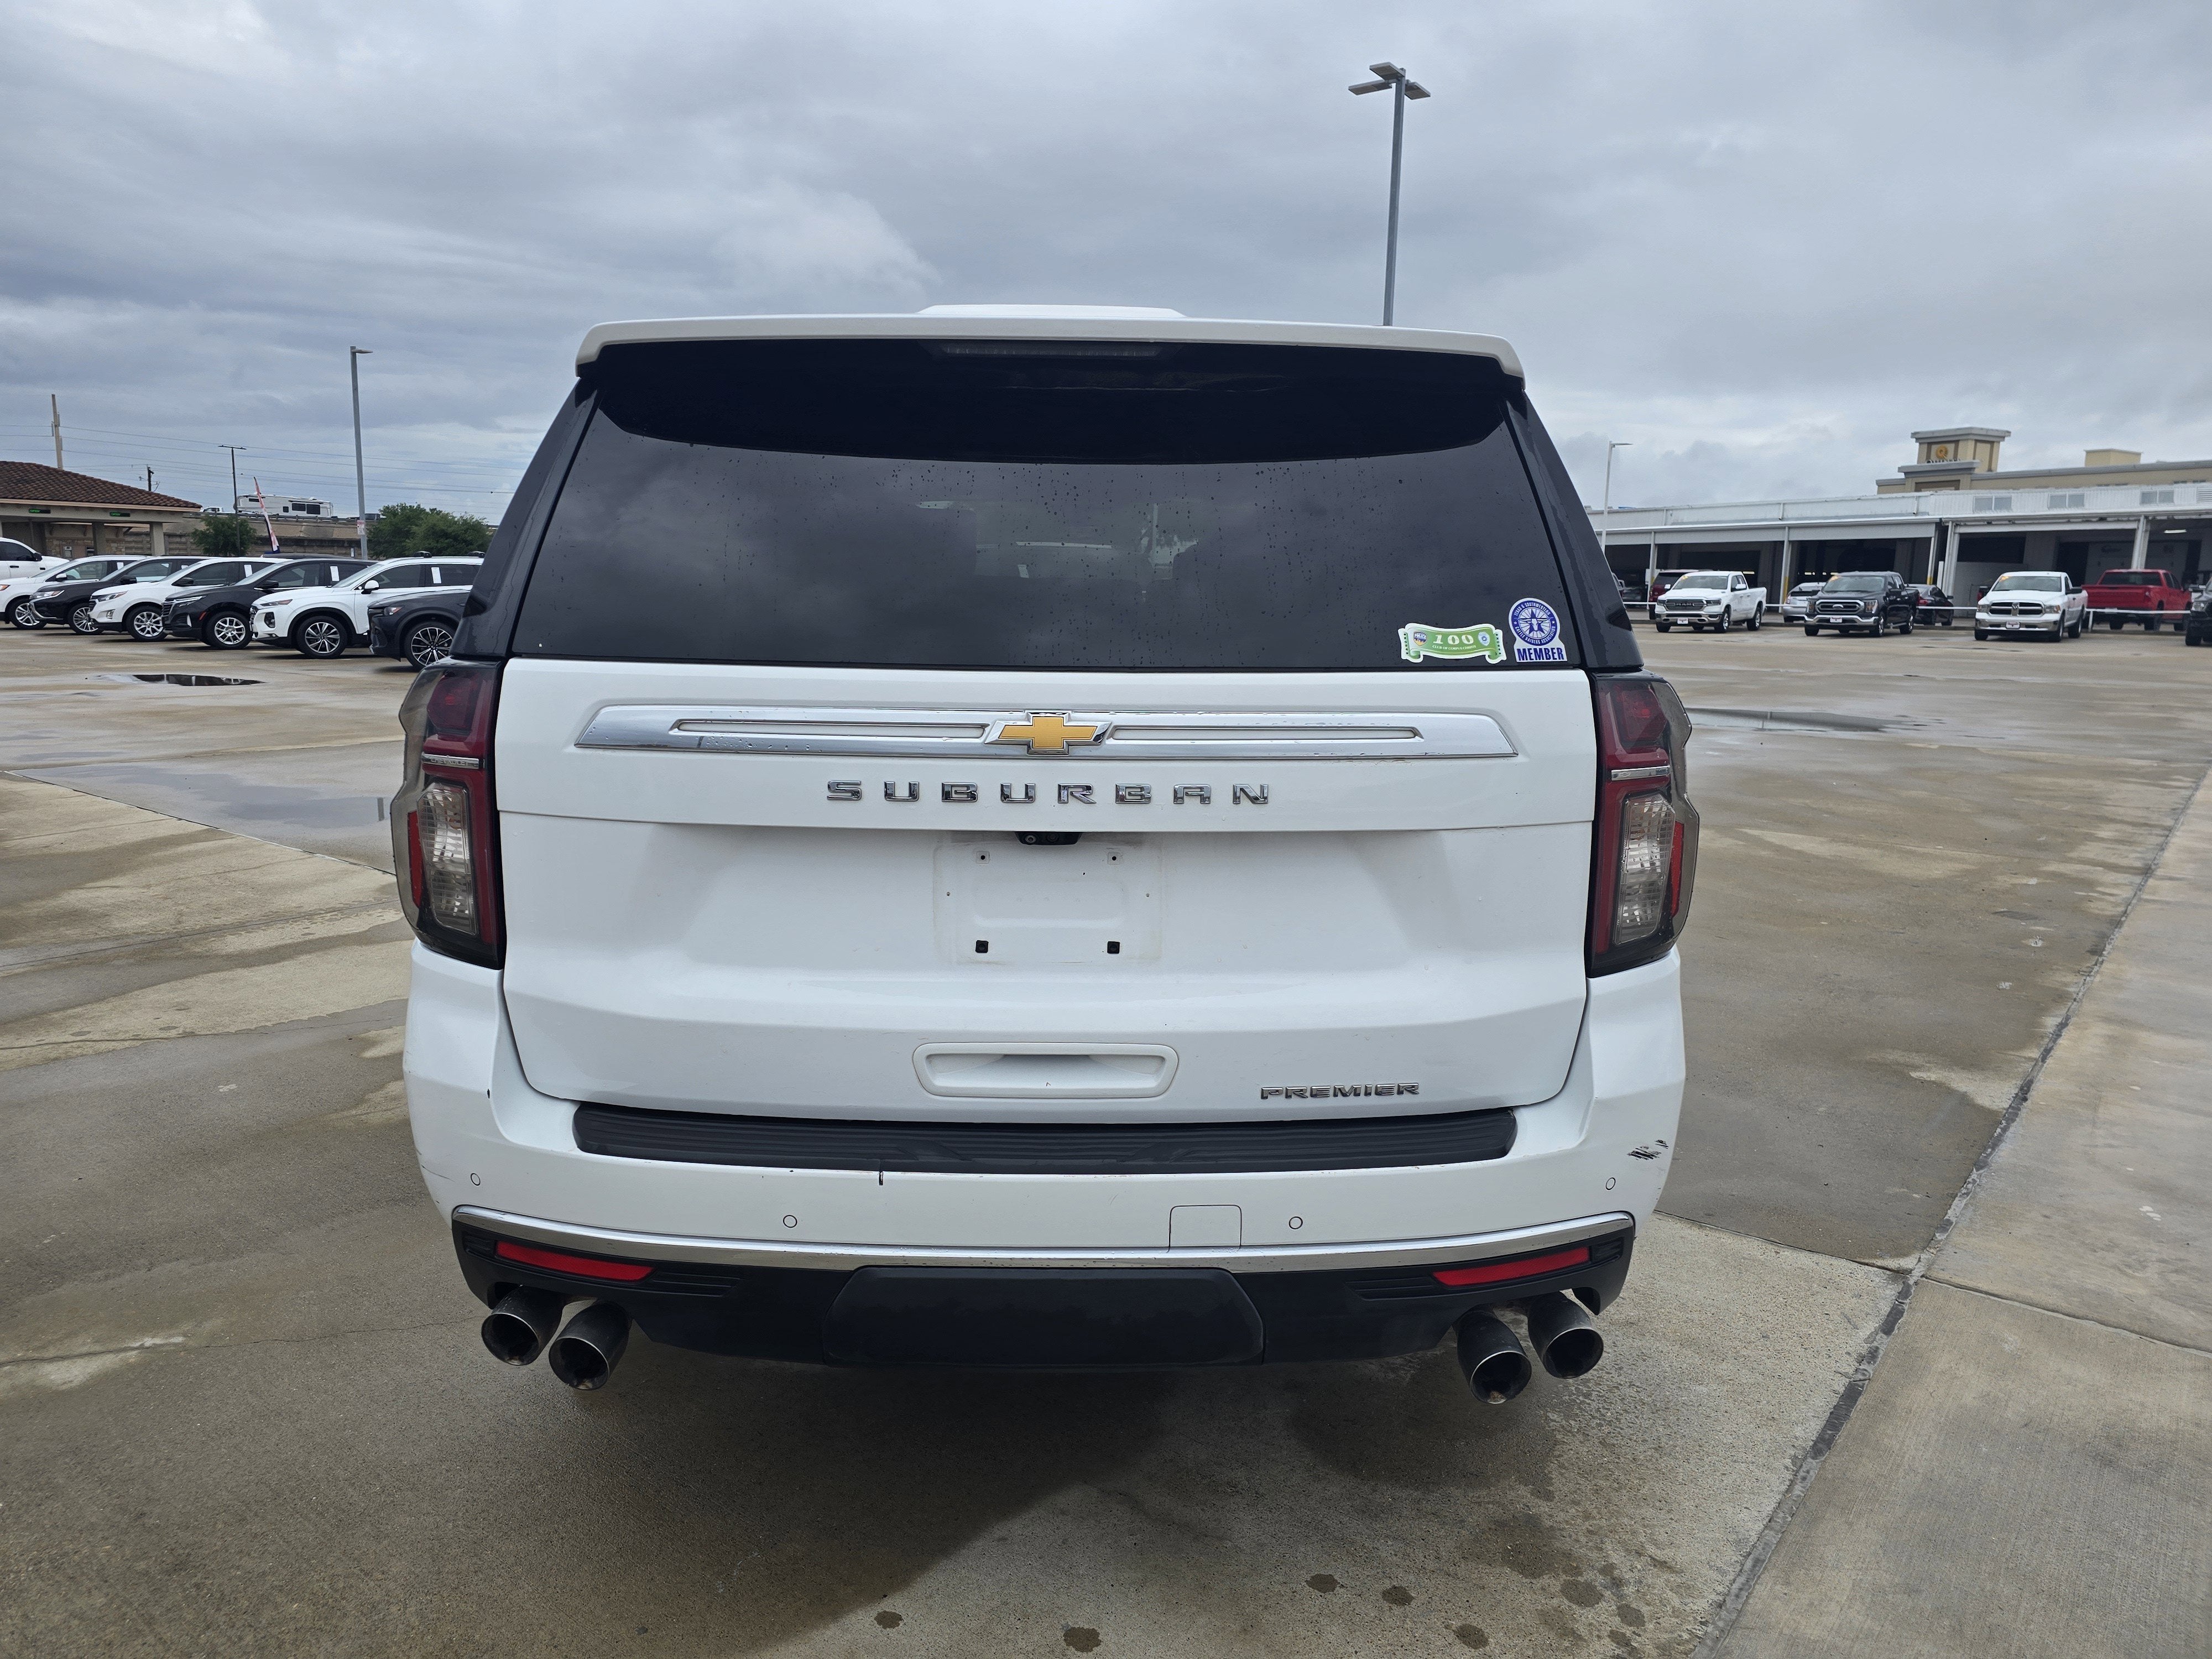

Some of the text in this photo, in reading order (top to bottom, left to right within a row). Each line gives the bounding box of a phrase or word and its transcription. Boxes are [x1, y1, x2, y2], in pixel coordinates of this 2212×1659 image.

[1433, 634, 1474, 645] 100
[1516, 647, 1564, 661] MEMBER
[826, 780, 1269, 805] SUBURBAN
[1261, 1082, 1420, 1099] PREMIER
